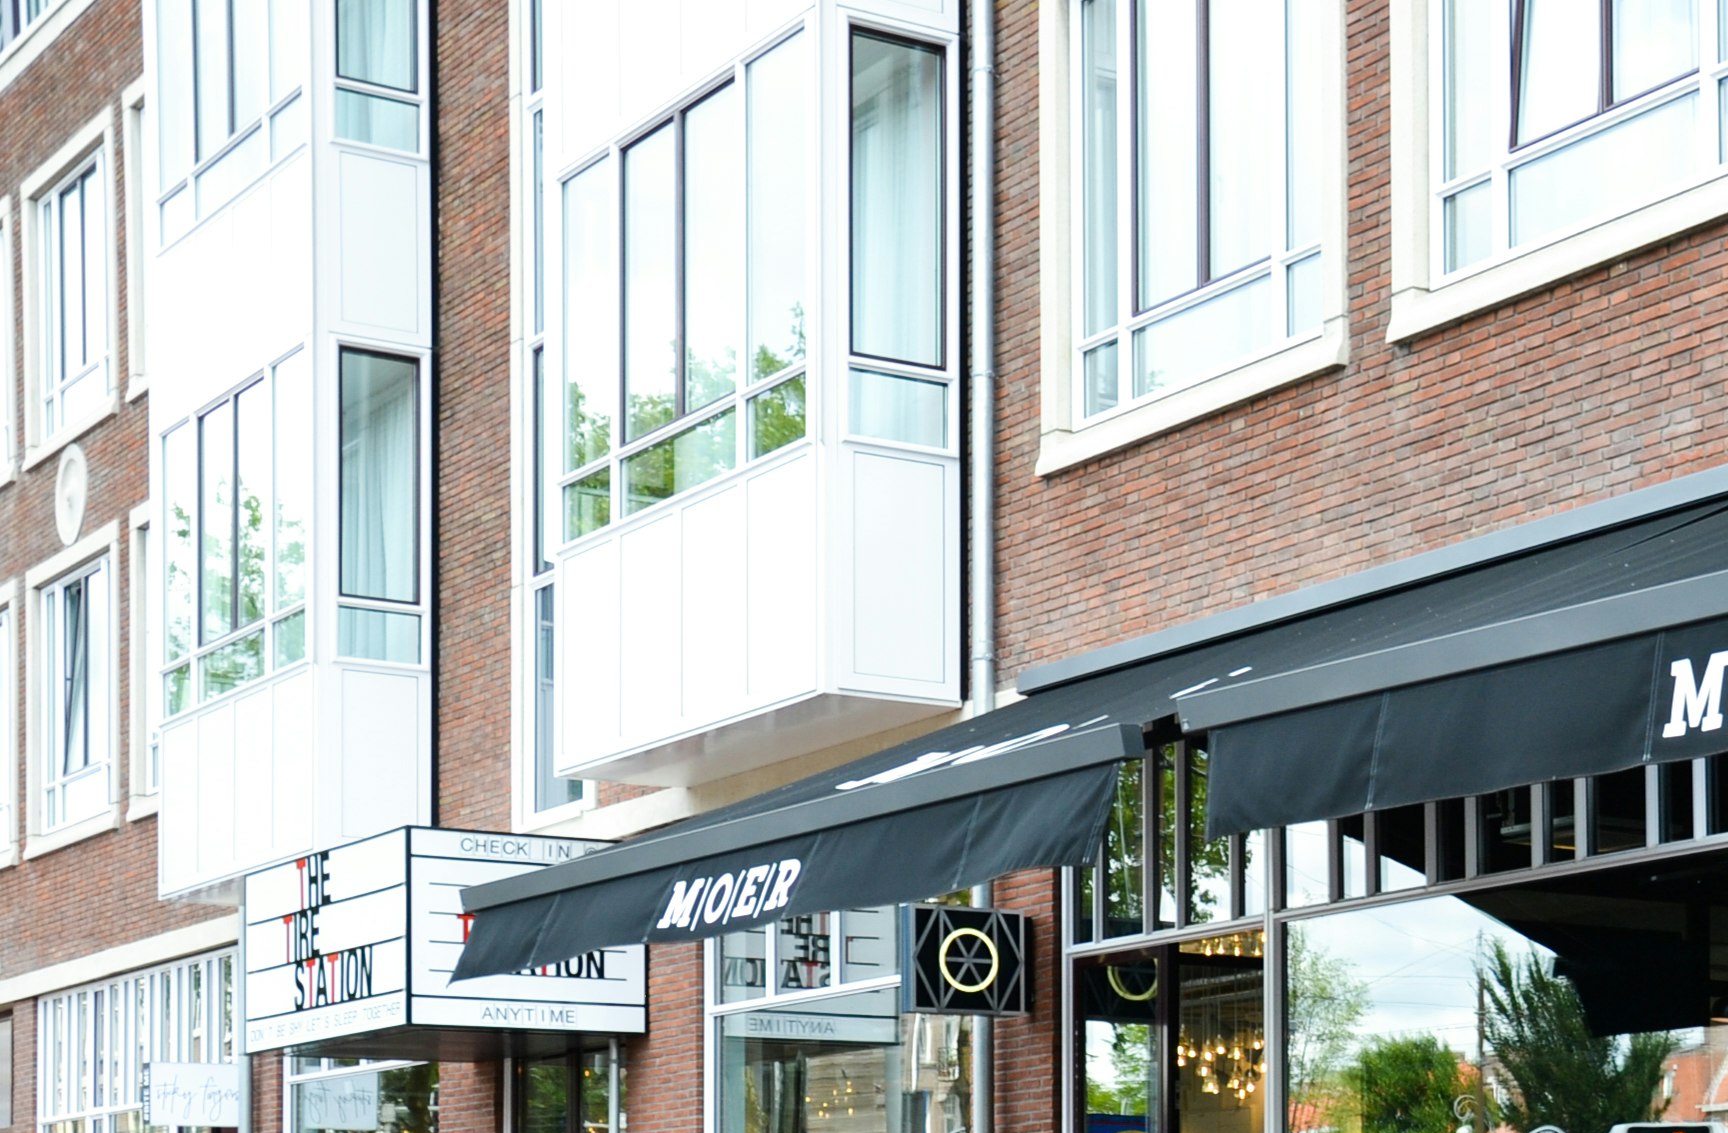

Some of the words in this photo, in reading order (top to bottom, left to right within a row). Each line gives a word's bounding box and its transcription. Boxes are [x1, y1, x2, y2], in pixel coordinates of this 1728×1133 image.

[460, 837, 528, 856] CHECK
[548, 843, 570, 858] IN
[296, 850, 331, 911] THE
[283, 906, 320, 964] TIRE
[294, 944, 373, 1012] STATION
[481, 1006, 576, 1024] ANYTIME
